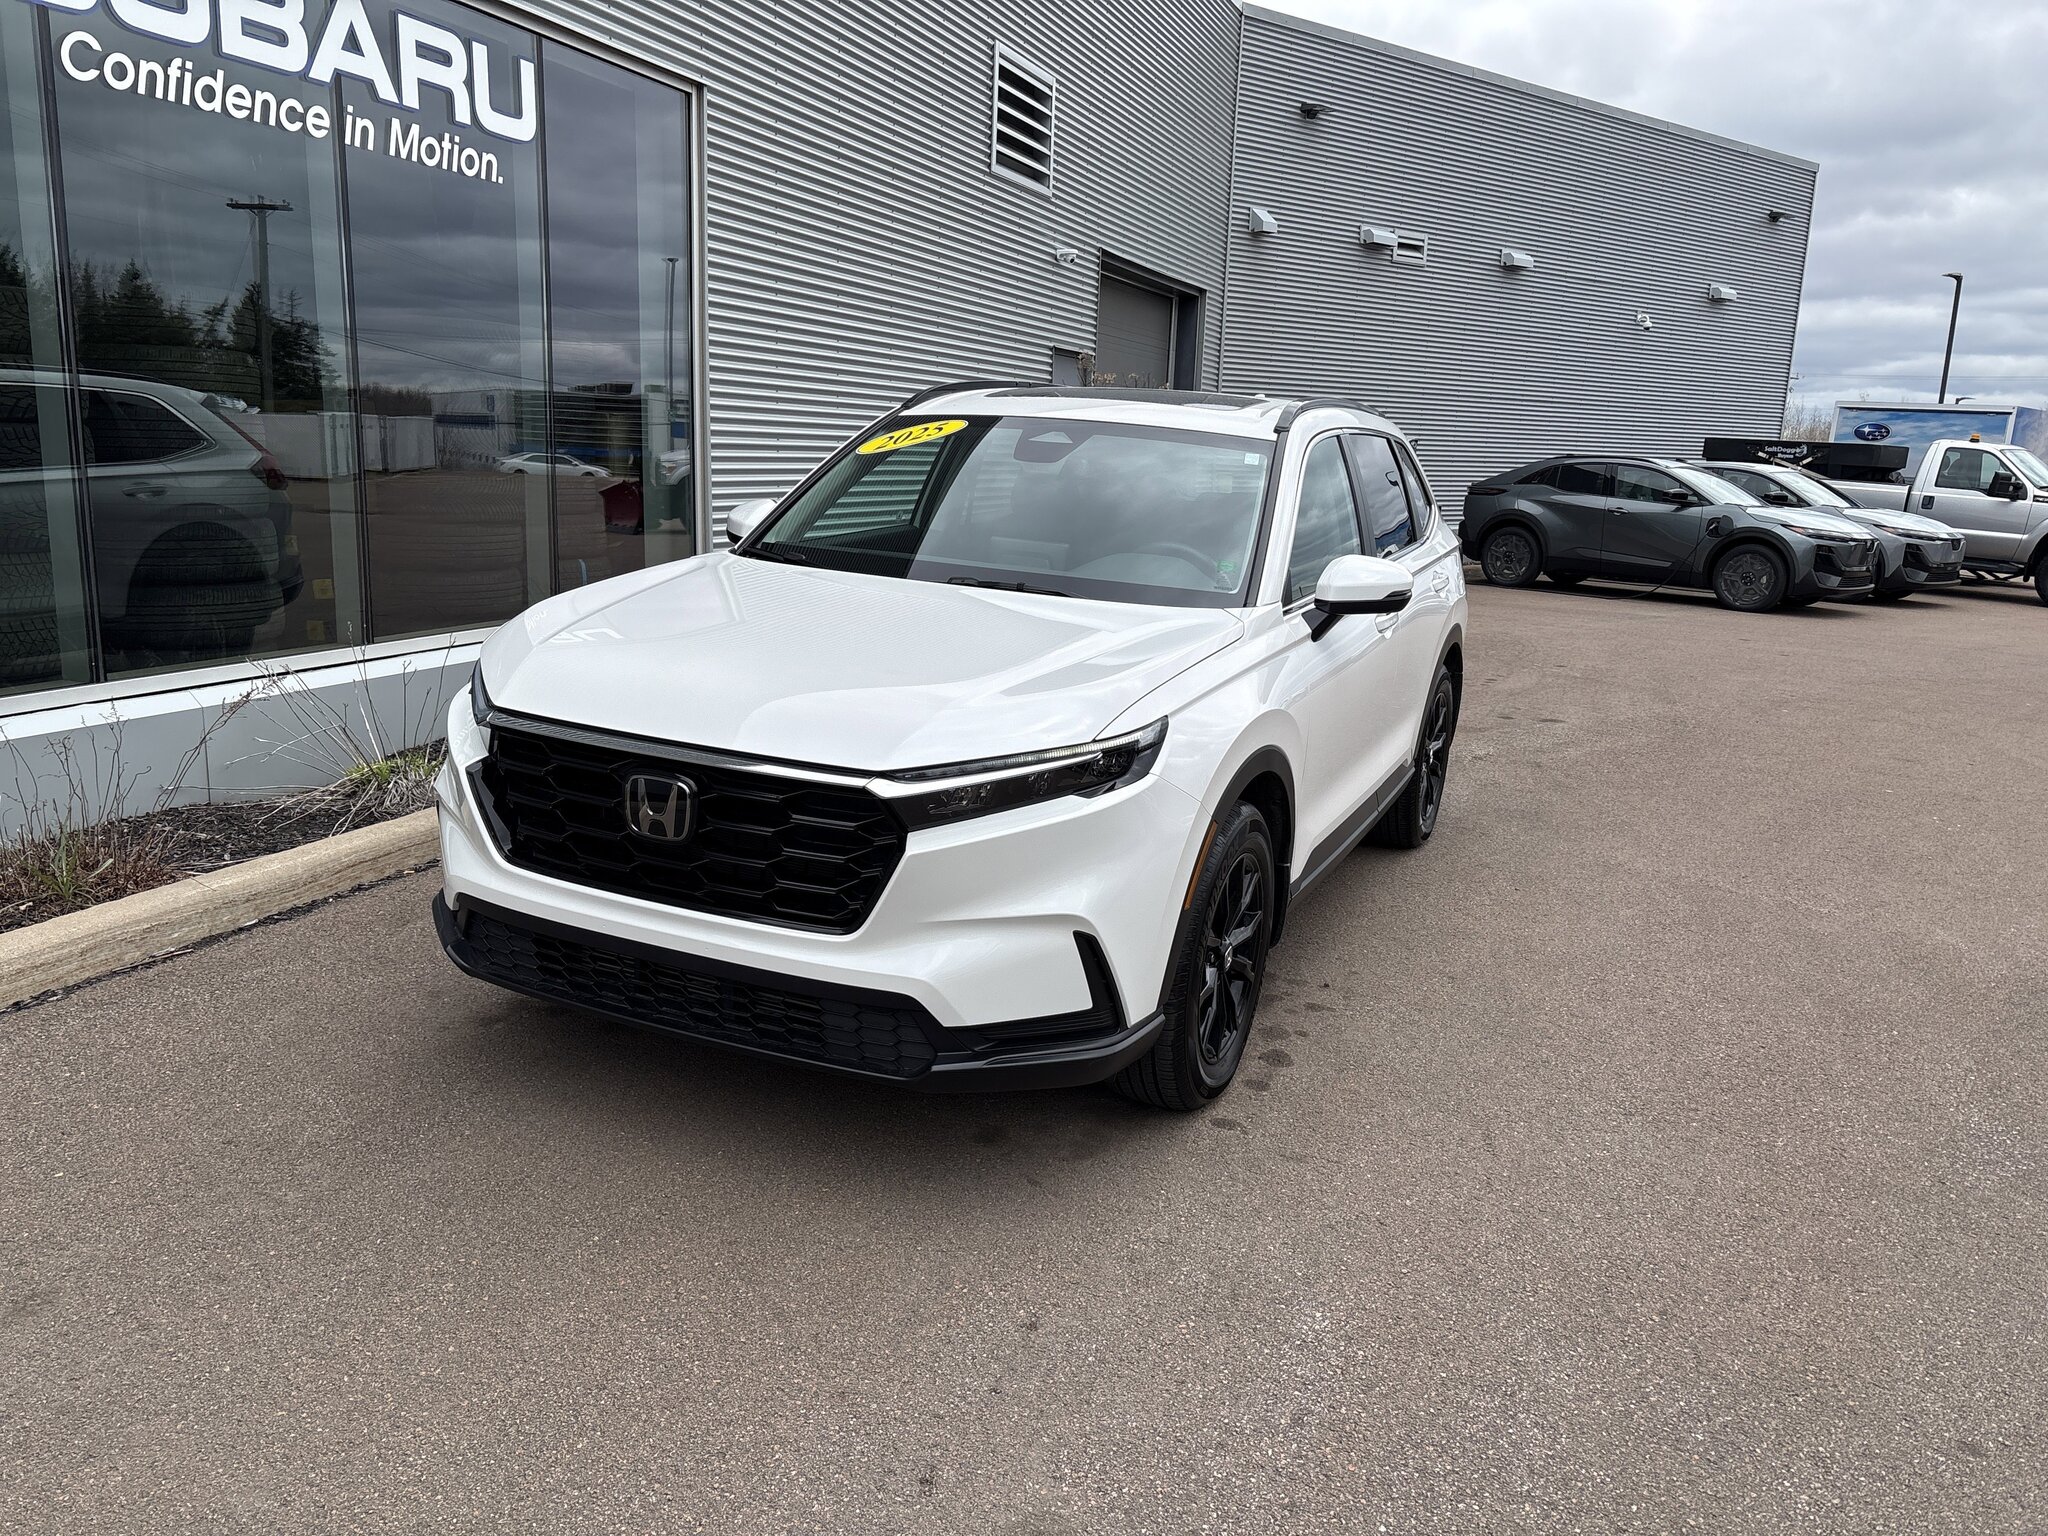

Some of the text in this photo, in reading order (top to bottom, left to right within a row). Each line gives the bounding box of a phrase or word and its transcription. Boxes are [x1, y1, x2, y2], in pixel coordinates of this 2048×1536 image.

[22, 0, 537, 143] BARU
[60, 30, 504, 185] Confidence in Motion.
[872, 422, 949, 451] 2025
